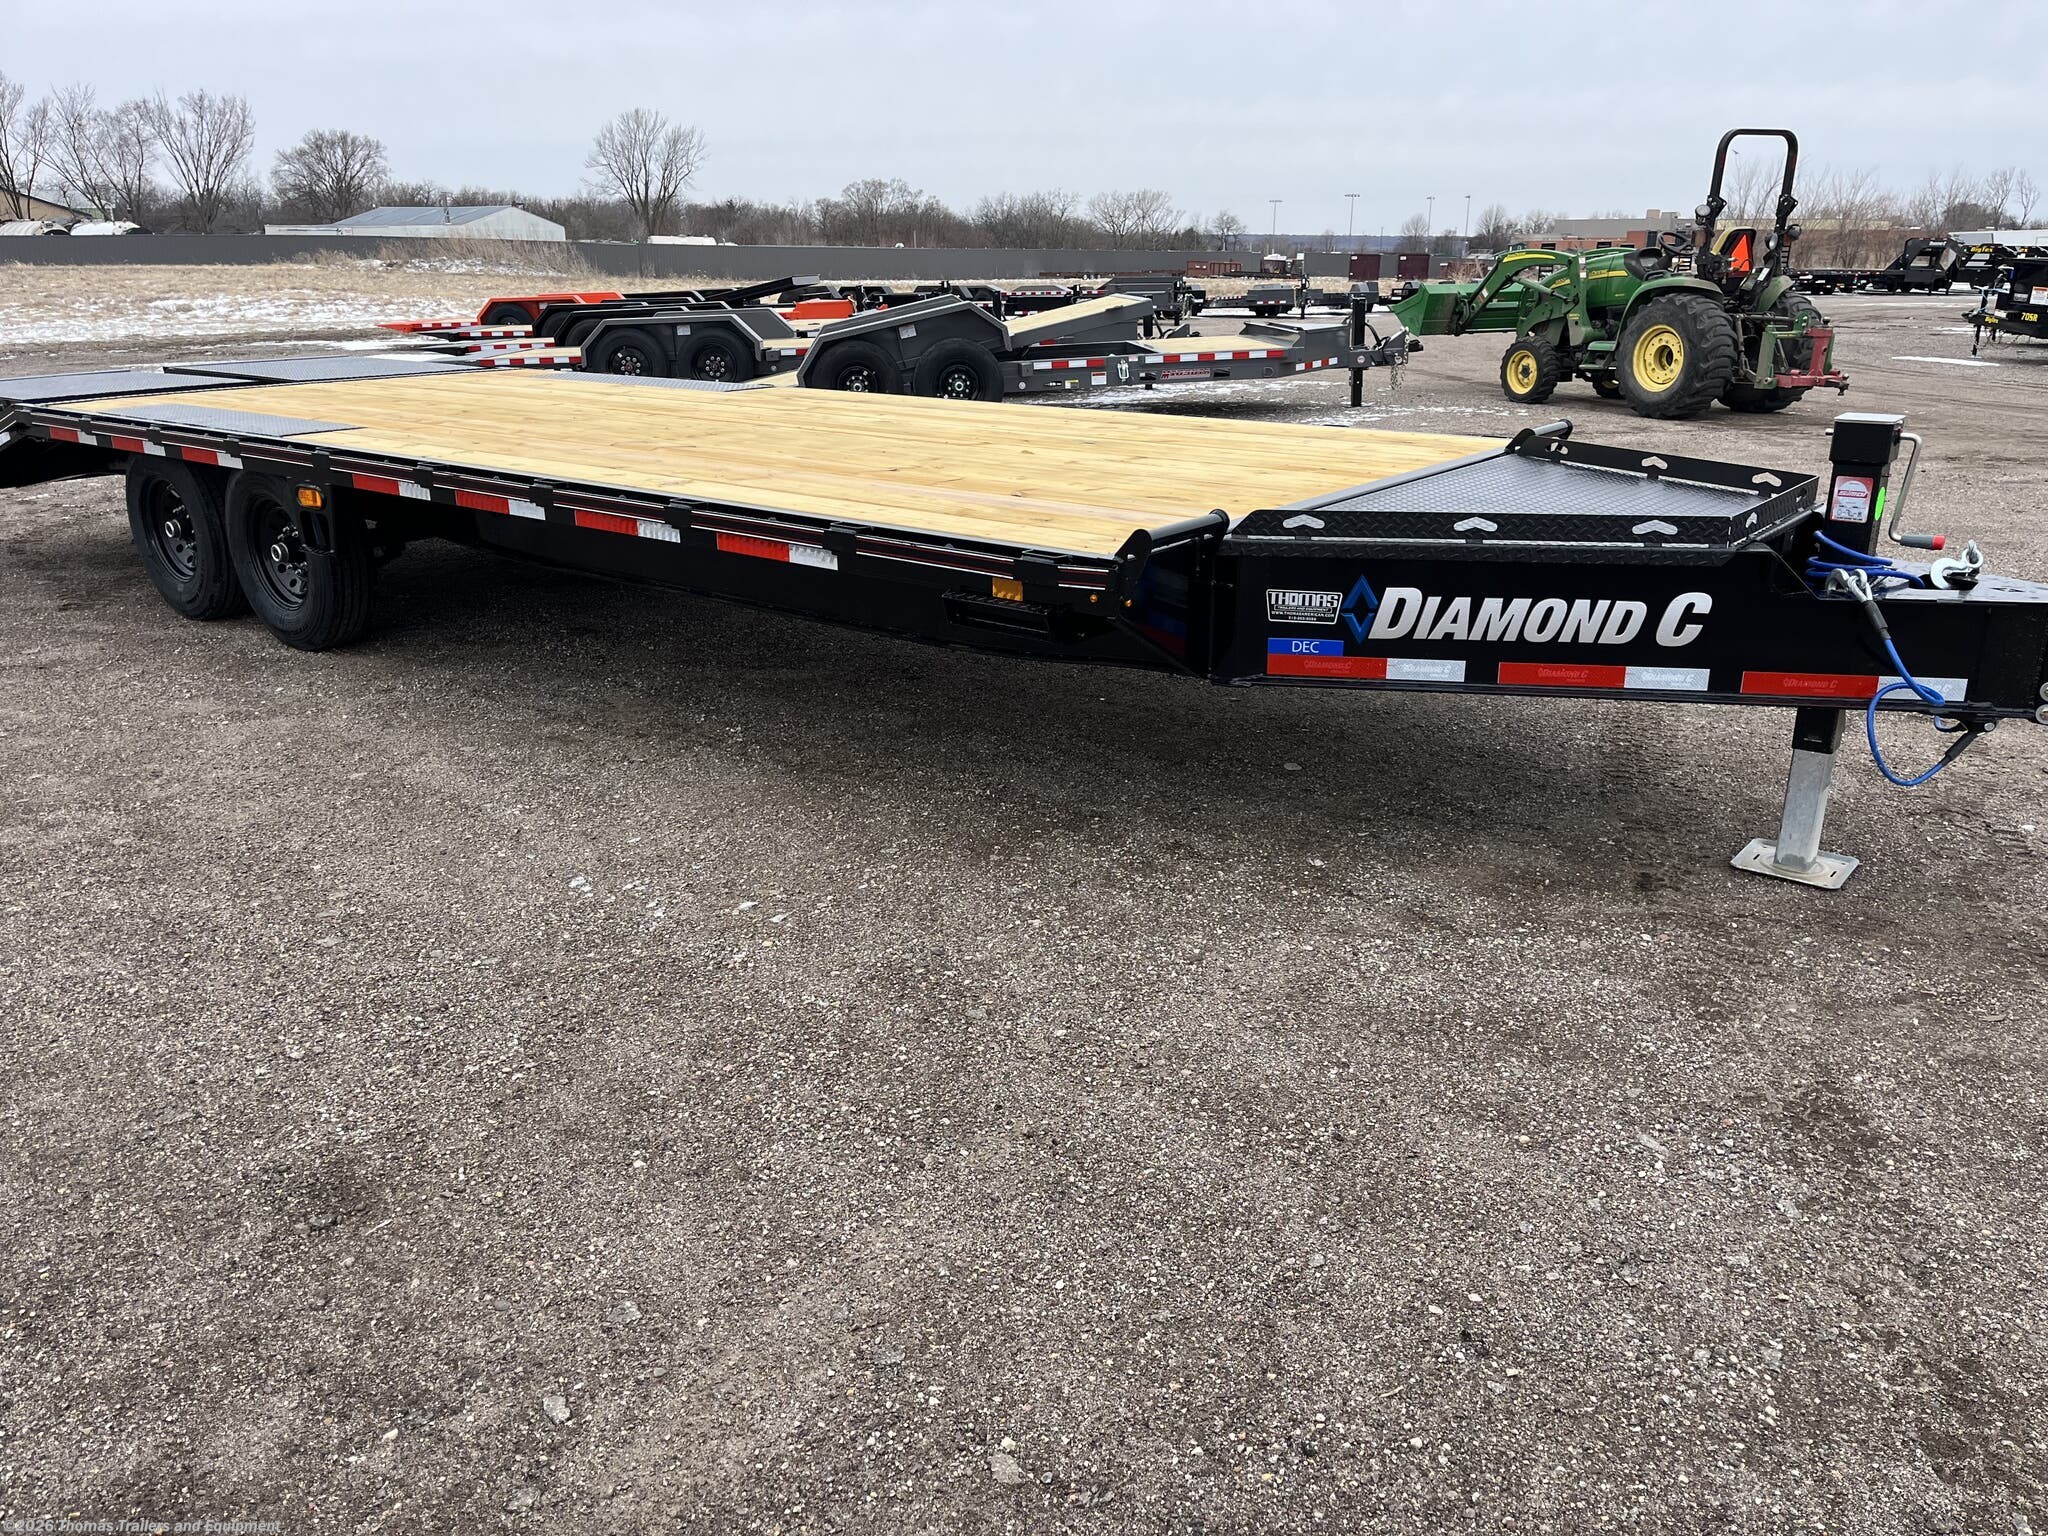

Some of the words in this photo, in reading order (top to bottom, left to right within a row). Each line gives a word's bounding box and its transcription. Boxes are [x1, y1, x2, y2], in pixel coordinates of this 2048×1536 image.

[1268, 592, 1339, 608] THOMAS
[1368, 587, 1648, 644] DIAMOND
[1656, 592, 1713, 647] C
[1292, 641, 1320, 653] DEC
